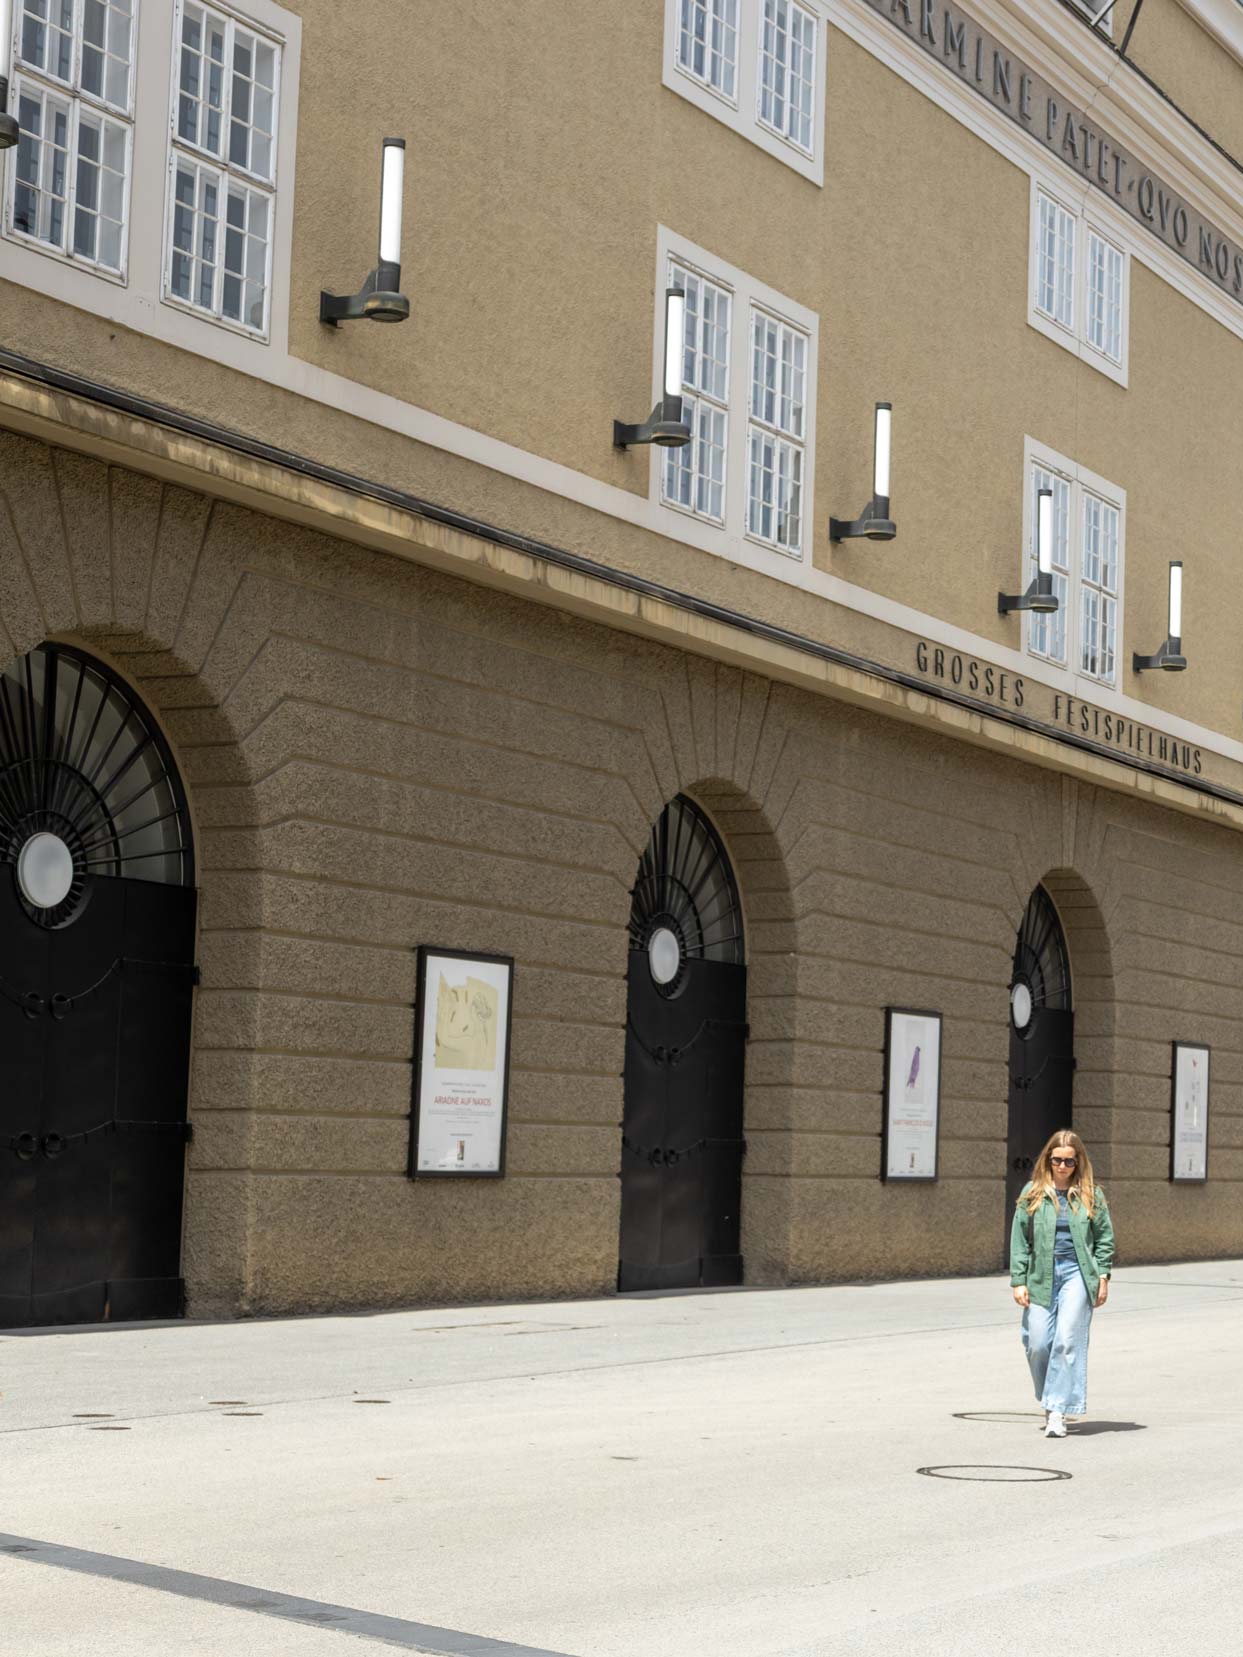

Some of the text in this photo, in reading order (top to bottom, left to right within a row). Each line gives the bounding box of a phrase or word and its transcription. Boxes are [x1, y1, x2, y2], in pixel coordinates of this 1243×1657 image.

[1138, 176, 1189, 247] QVO
[1199, 225, 1243, 293] NOS
[916, 641, 1202, 774] GROSSES FESTSPIELHAUS
